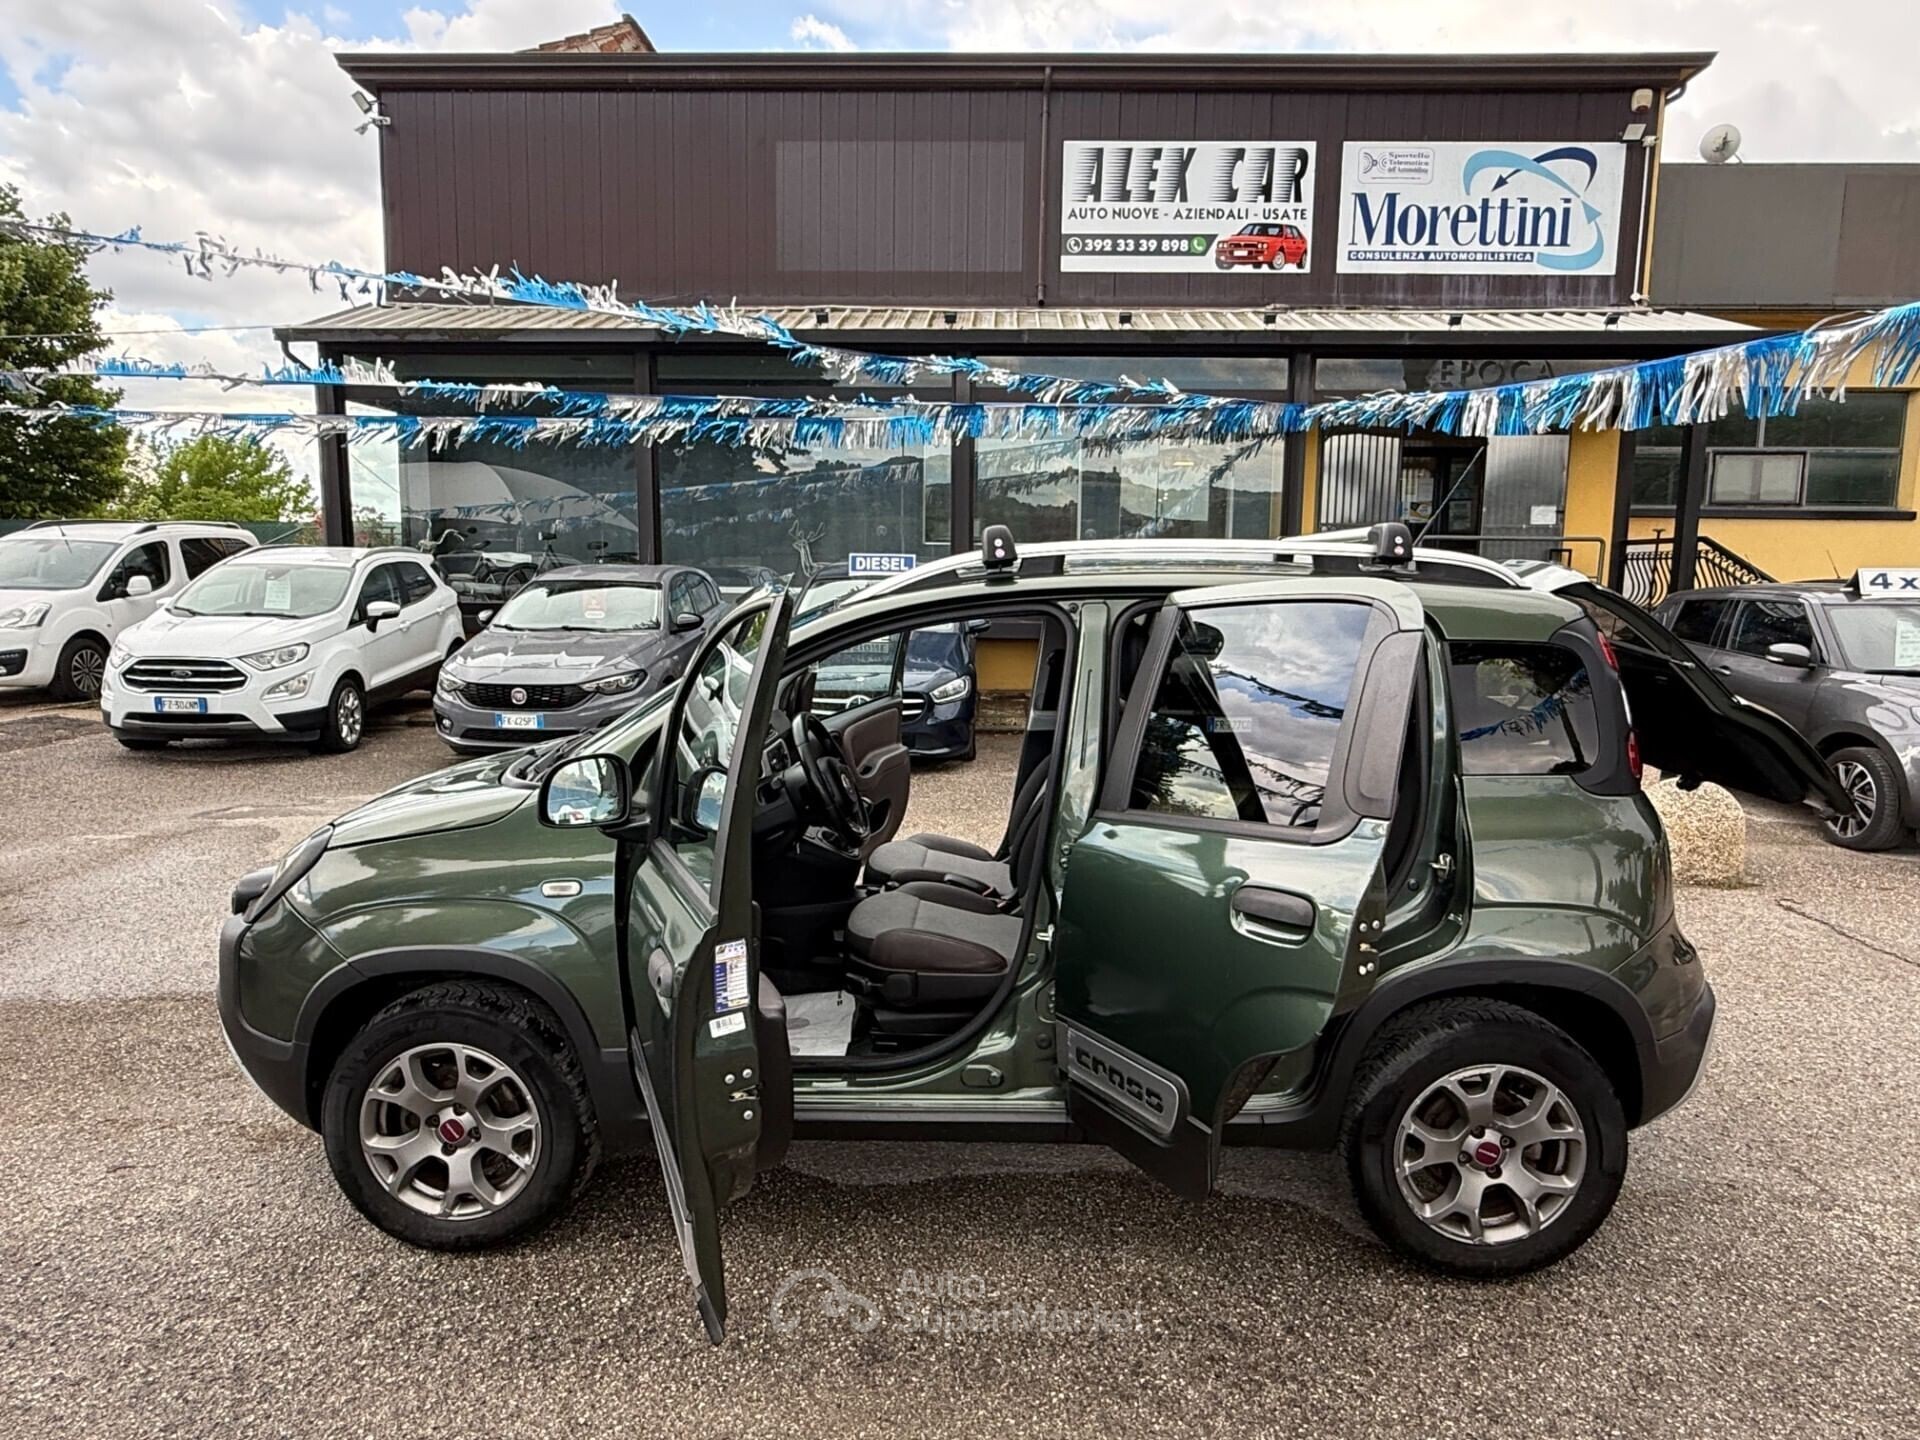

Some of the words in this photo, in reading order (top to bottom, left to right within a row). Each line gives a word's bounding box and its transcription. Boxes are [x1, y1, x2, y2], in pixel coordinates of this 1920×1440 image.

[1070, 147, 1197, 203] ALEX
[1207, 147, 1309, 203] CAR
[1067, 207, 1108, 220] AUTO
[1112, 207, 1159, 220] NUOVE
[1173, 208, 1249, 220] AZIENDALI
[1262, 208, 1308, 221] USATE
[1348, 192, 1572, 247] Morettini
[1084, 239, 1113, 252] 392
[1116, 239, 1136, 252] 33
[1139, 239, 1158, 252] 39
[1161, 239, 1189, 252] 898
[1349, 251, 1425, 261] CONSULENZA
[1428, 252, 1533, 263] AUTOMOBILISTICA
[855, 556, 910, 571] DIESEL
